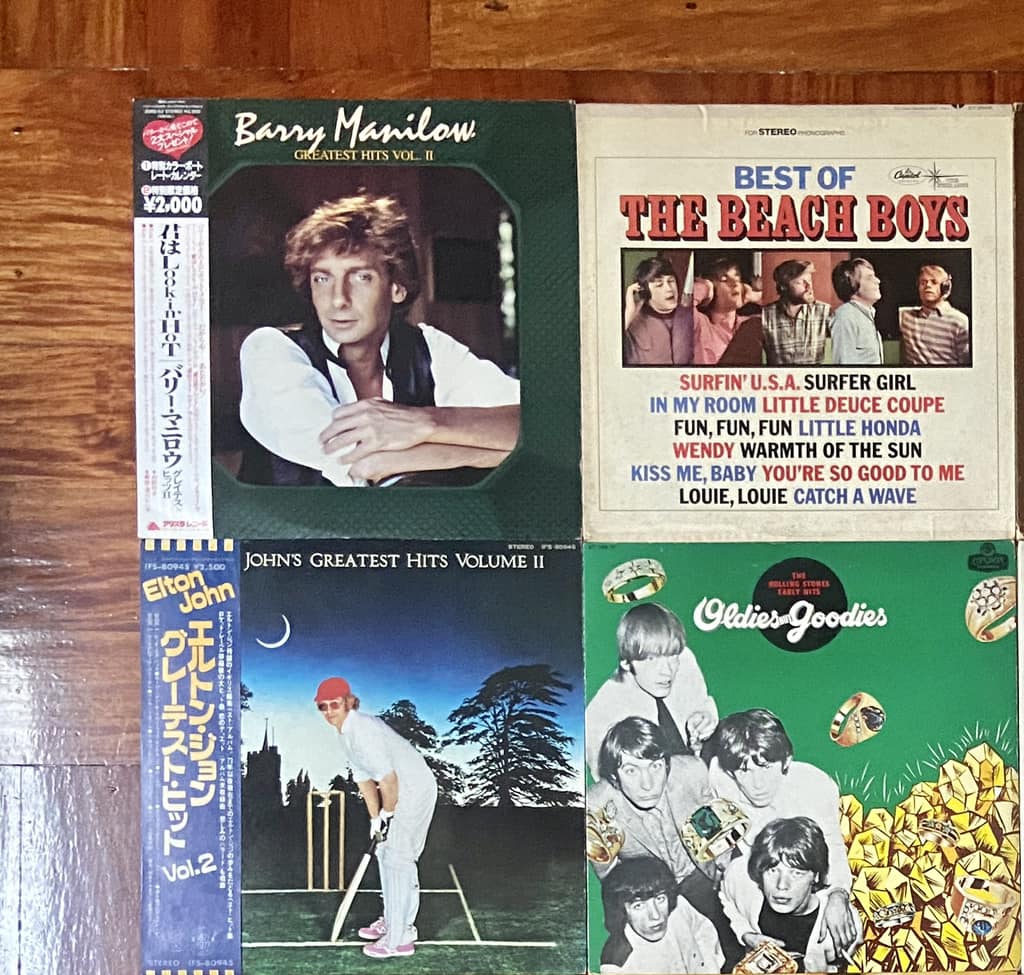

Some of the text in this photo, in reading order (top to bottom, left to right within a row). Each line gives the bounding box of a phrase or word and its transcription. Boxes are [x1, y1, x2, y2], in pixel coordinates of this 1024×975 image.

[234, 111, 326, 153] Barry
[334, 105, 476, 148] Manilow
[758, 128, 797, 136] STEREO
[294, 150, 358, 161] GREATEST
[361, 150, 389, 161] HITS
[425, 150, 434, 161] II
[734, 166, 856, 190] BEST OF
[143, 196, 203, 213] ¥2,000
[620, 193, 970, 242] THE BEACH BOYS
[679, 374, 916, 391] SURFIN' U.S.A. SURFER GIRL
[650, 397, 945, 413] IN MY ROOM LITTLE DEUCE COUPE
[674, 419, 921, 439] FUN, FUN, FUN LITTLE HONDA
[672, 442, 922, 459] WENDY WARMTH OF THE SUN
[630, 465, 965, 485] KISS ME, BABY YOU'RE SO GOOD TO ME
[679, 488, 917, 508] LOUIE, LOUIE CATCH A WAVE
[244, 552, 545, 572] JOHN'S GREATEST HITS VOLUME II
[142, 570, 205, 602] Elton
[768, 580, 830, 588] ROLLING STONES
[179, 582, 235, 613] John
[693, 596, 888, 644] Oldies Goodies
[187, 620, 218, 807] エルトン・ジョン
[162, 852, 217, 882] Vol.2
